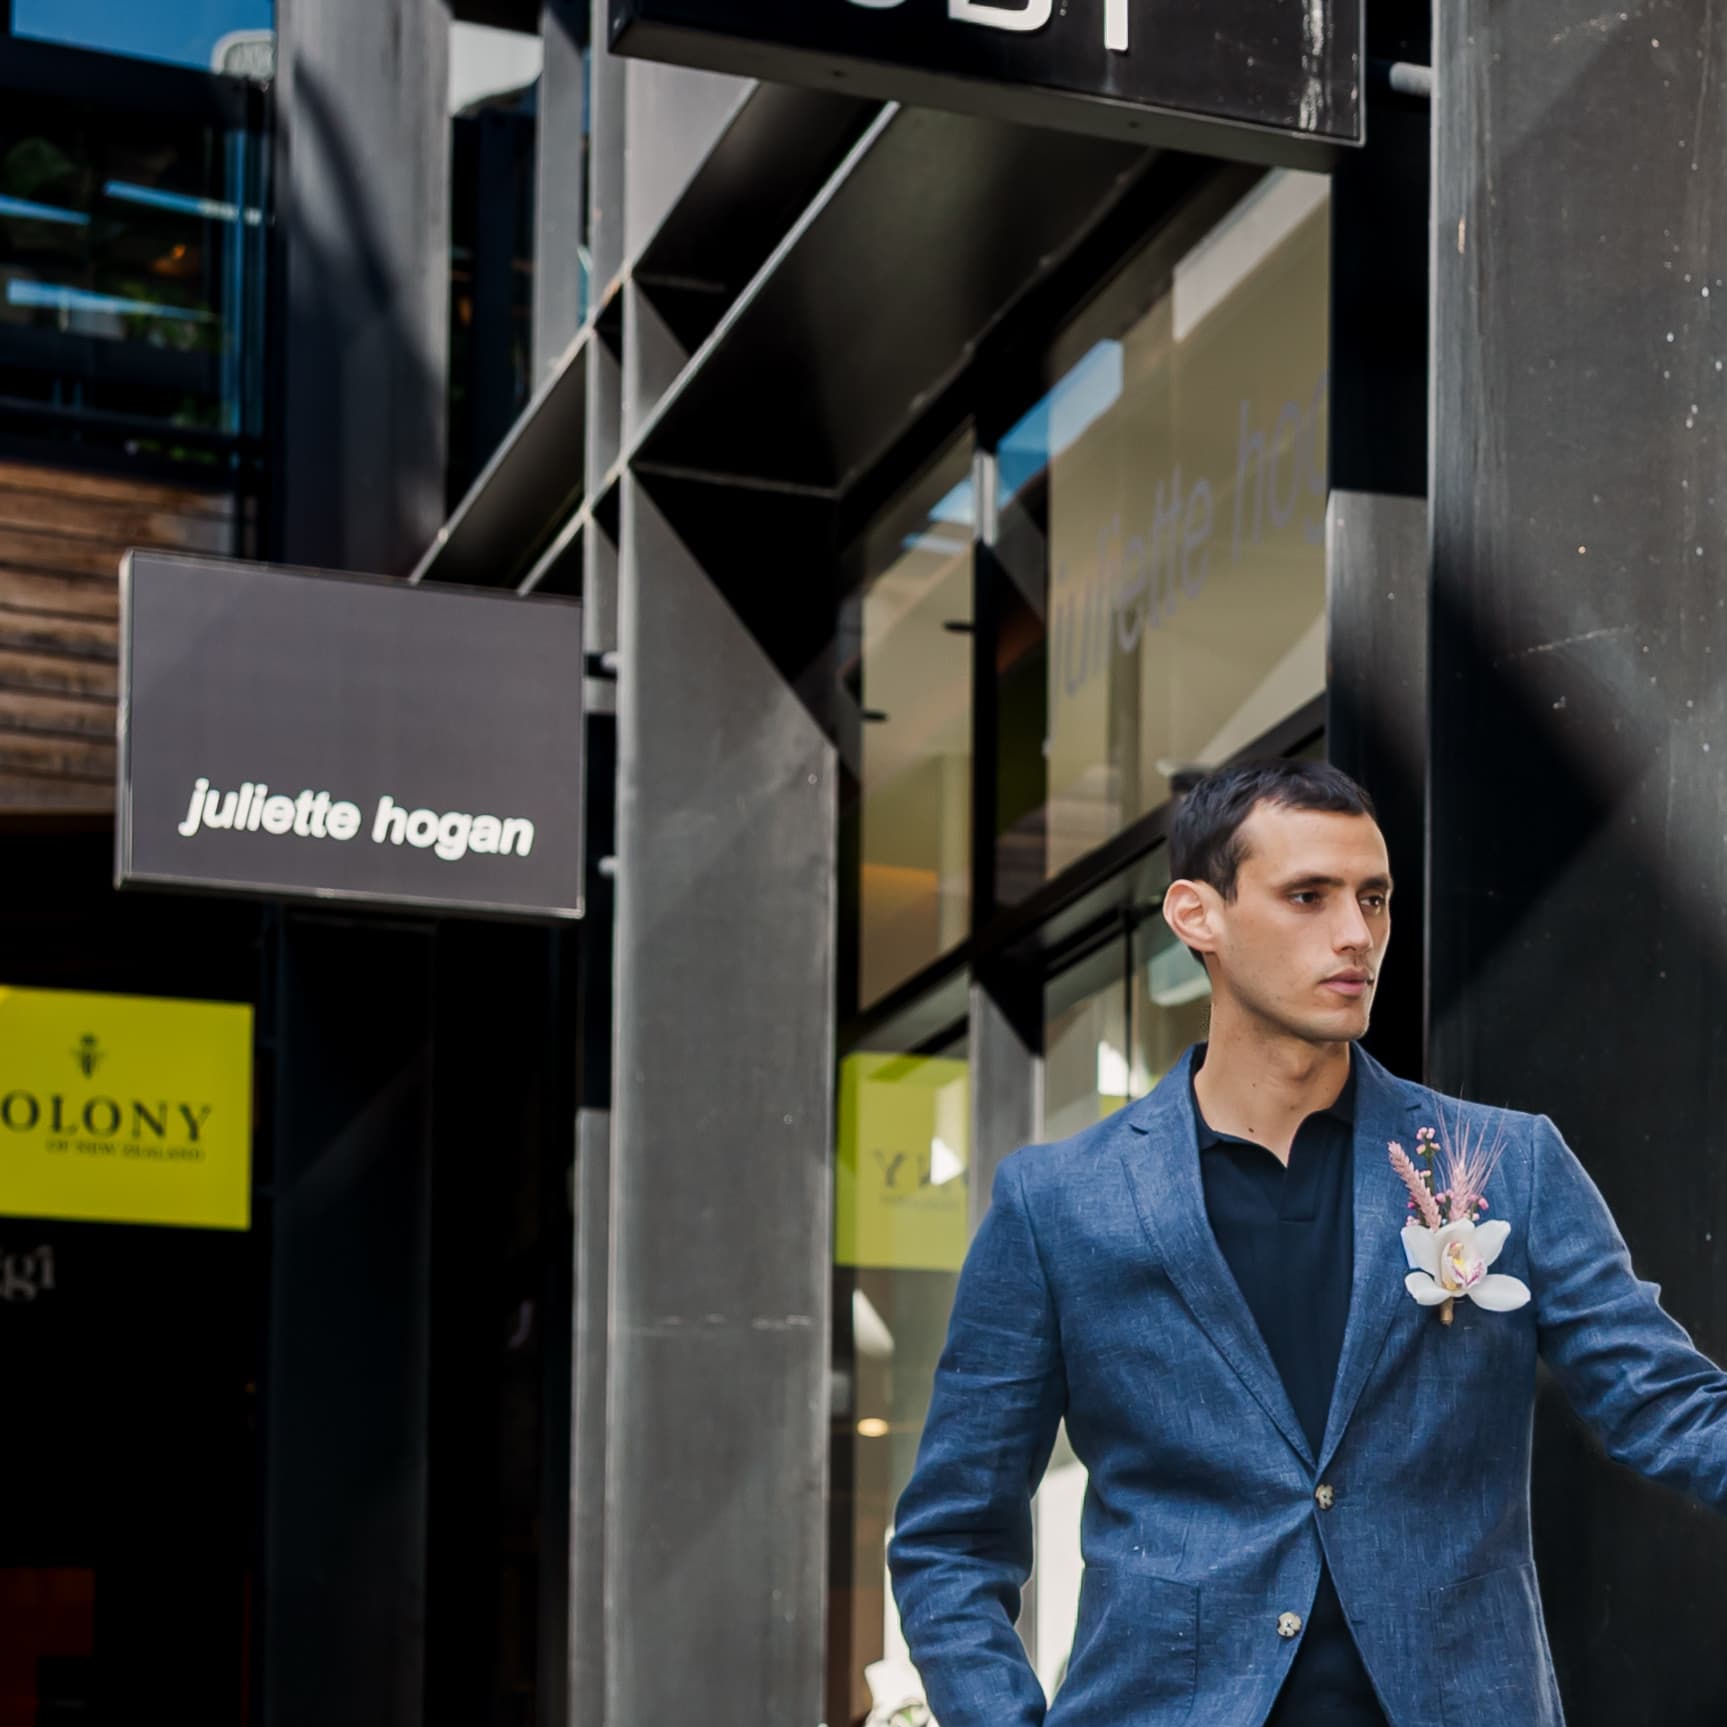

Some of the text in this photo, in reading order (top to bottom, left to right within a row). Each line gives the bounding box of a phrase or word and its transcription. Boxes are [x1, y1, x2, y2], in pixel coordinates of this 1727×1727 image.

[178, 777, 535, 861] juliette hogan
[0, 1088, 212, 1142] OLONY
